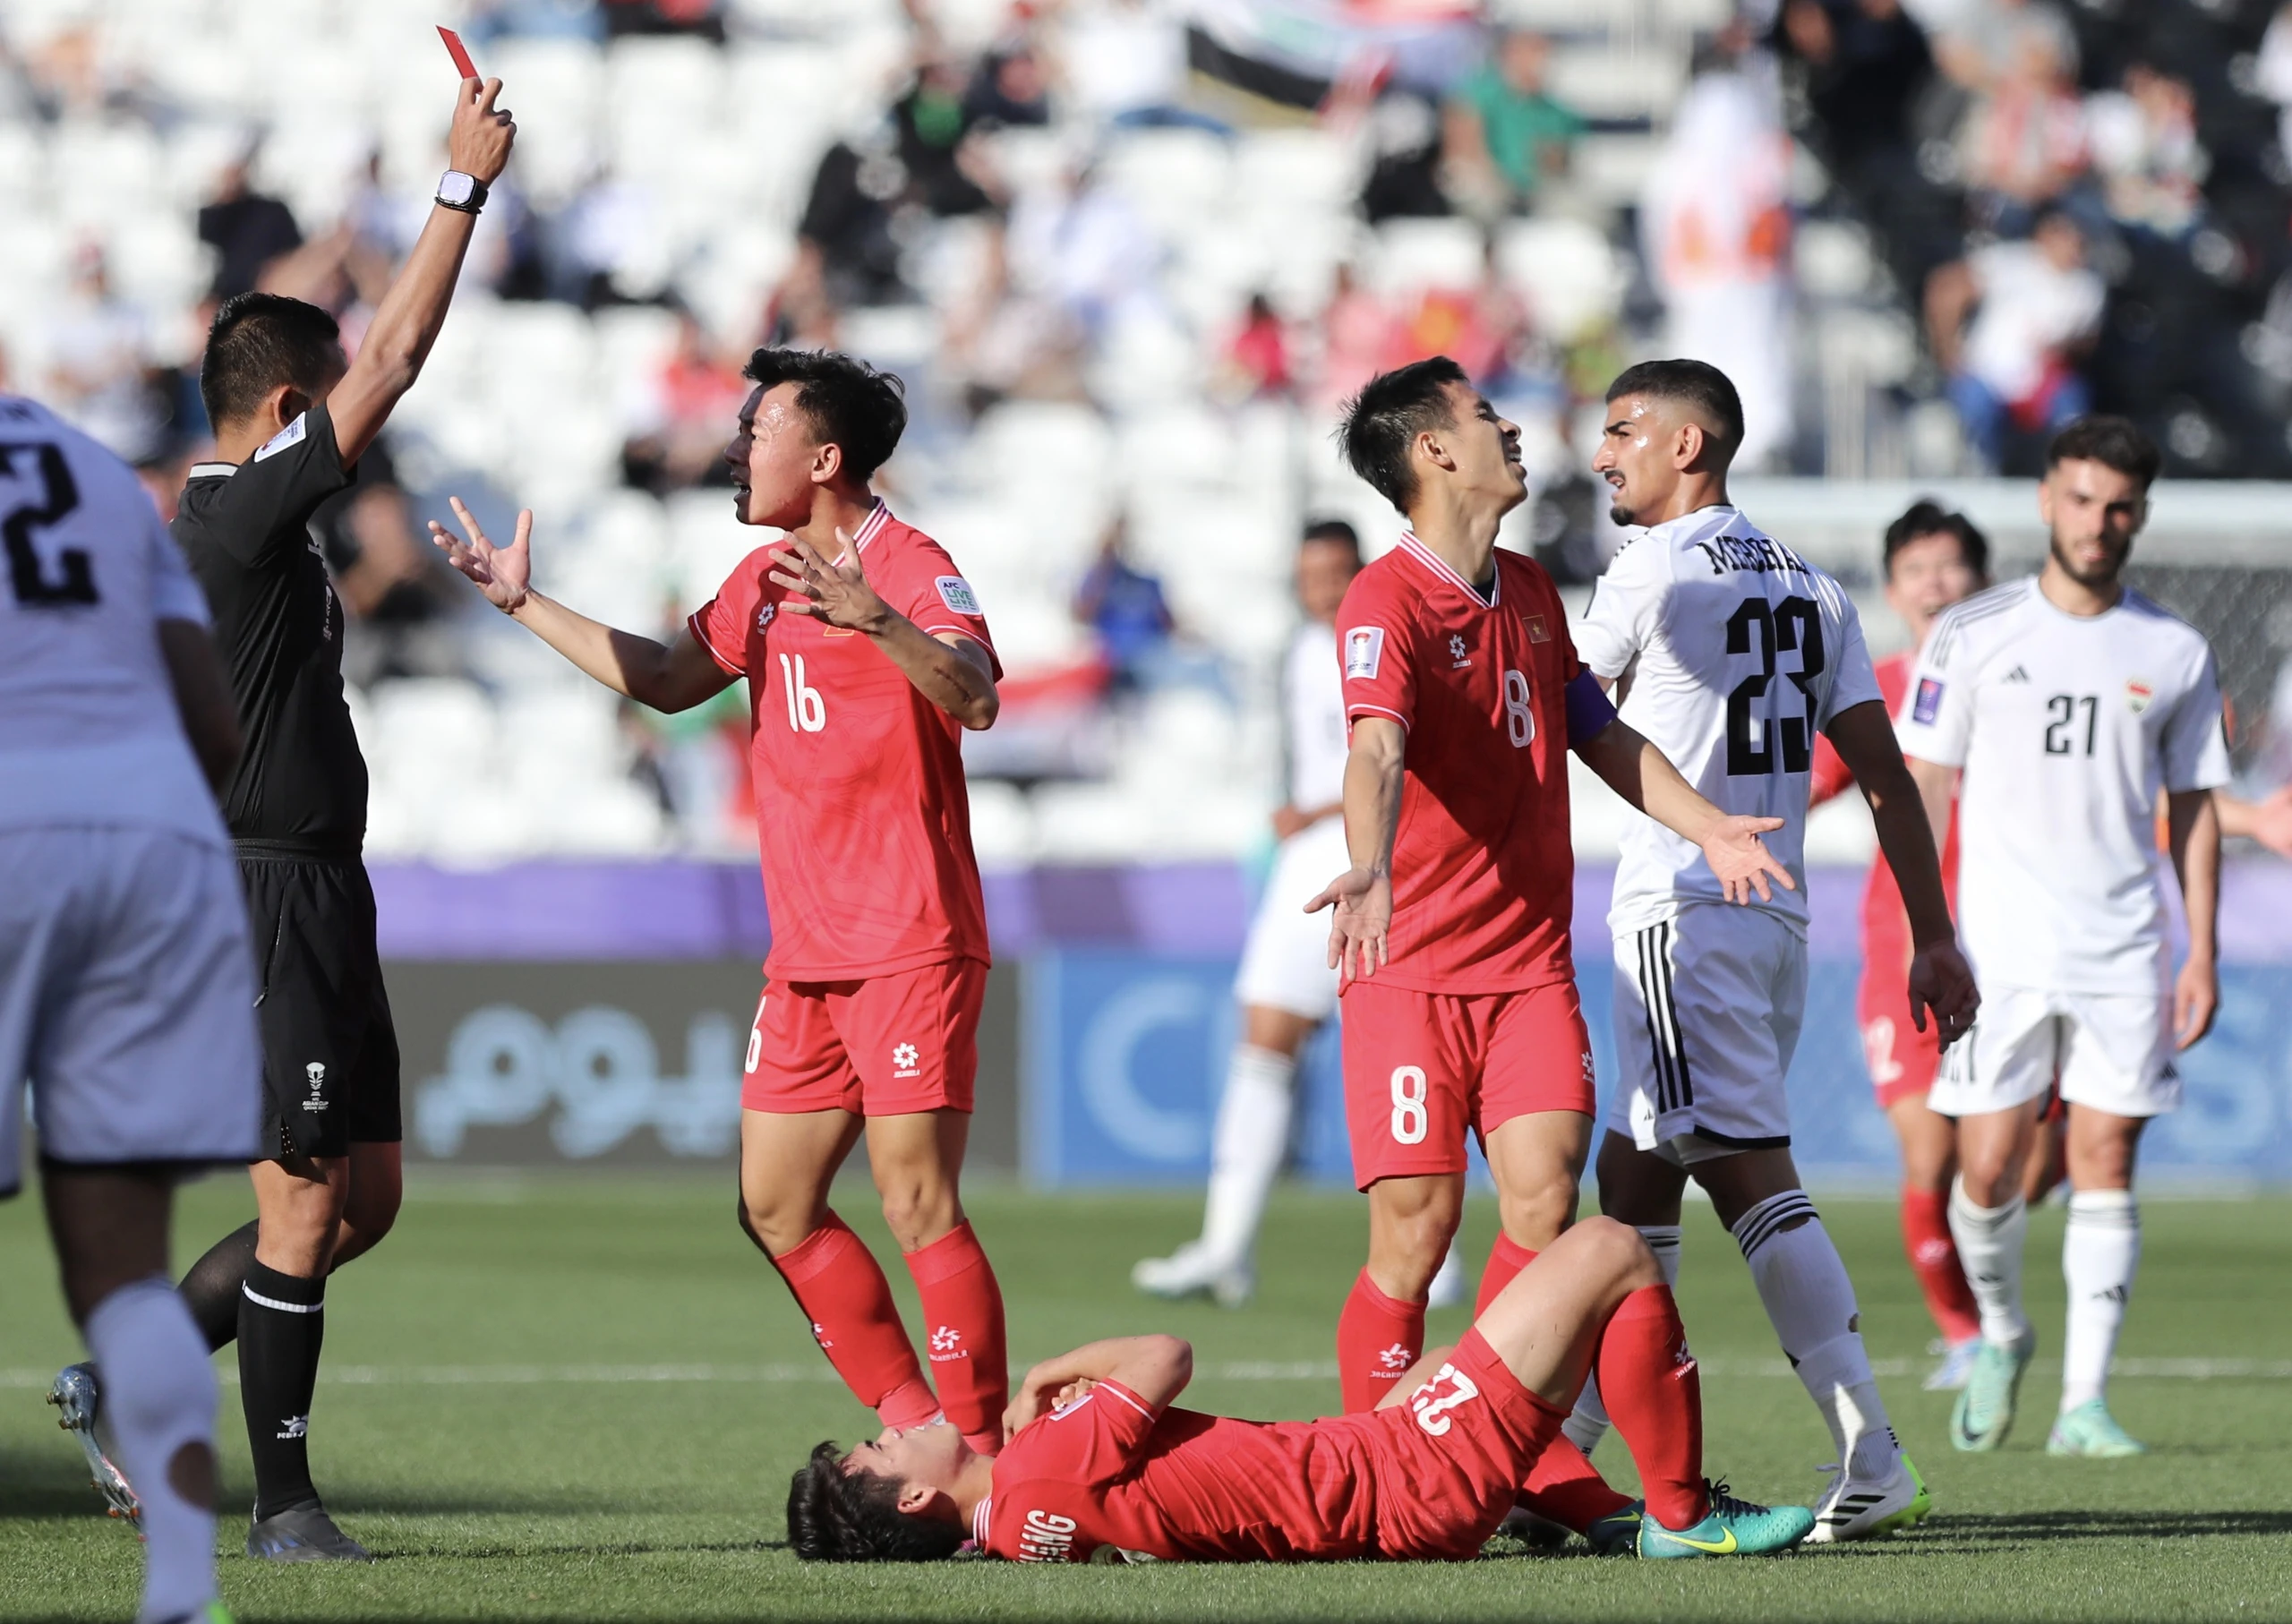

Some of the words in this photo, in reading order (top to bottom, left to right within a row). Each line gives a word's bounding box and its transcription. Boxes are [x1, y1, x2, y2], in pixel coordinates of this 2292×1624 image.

[945, 588, 972, 600] LIVE
[779, 653, 826, 733] 16
[1503, 669, 1536, 748] 8
[1726, 595, 1824, 776] 23
[2045, 695, 2100, 756] 21
[745, 995, 767, 1074] 6
[1390, 1064, 1428, 1145] 8
